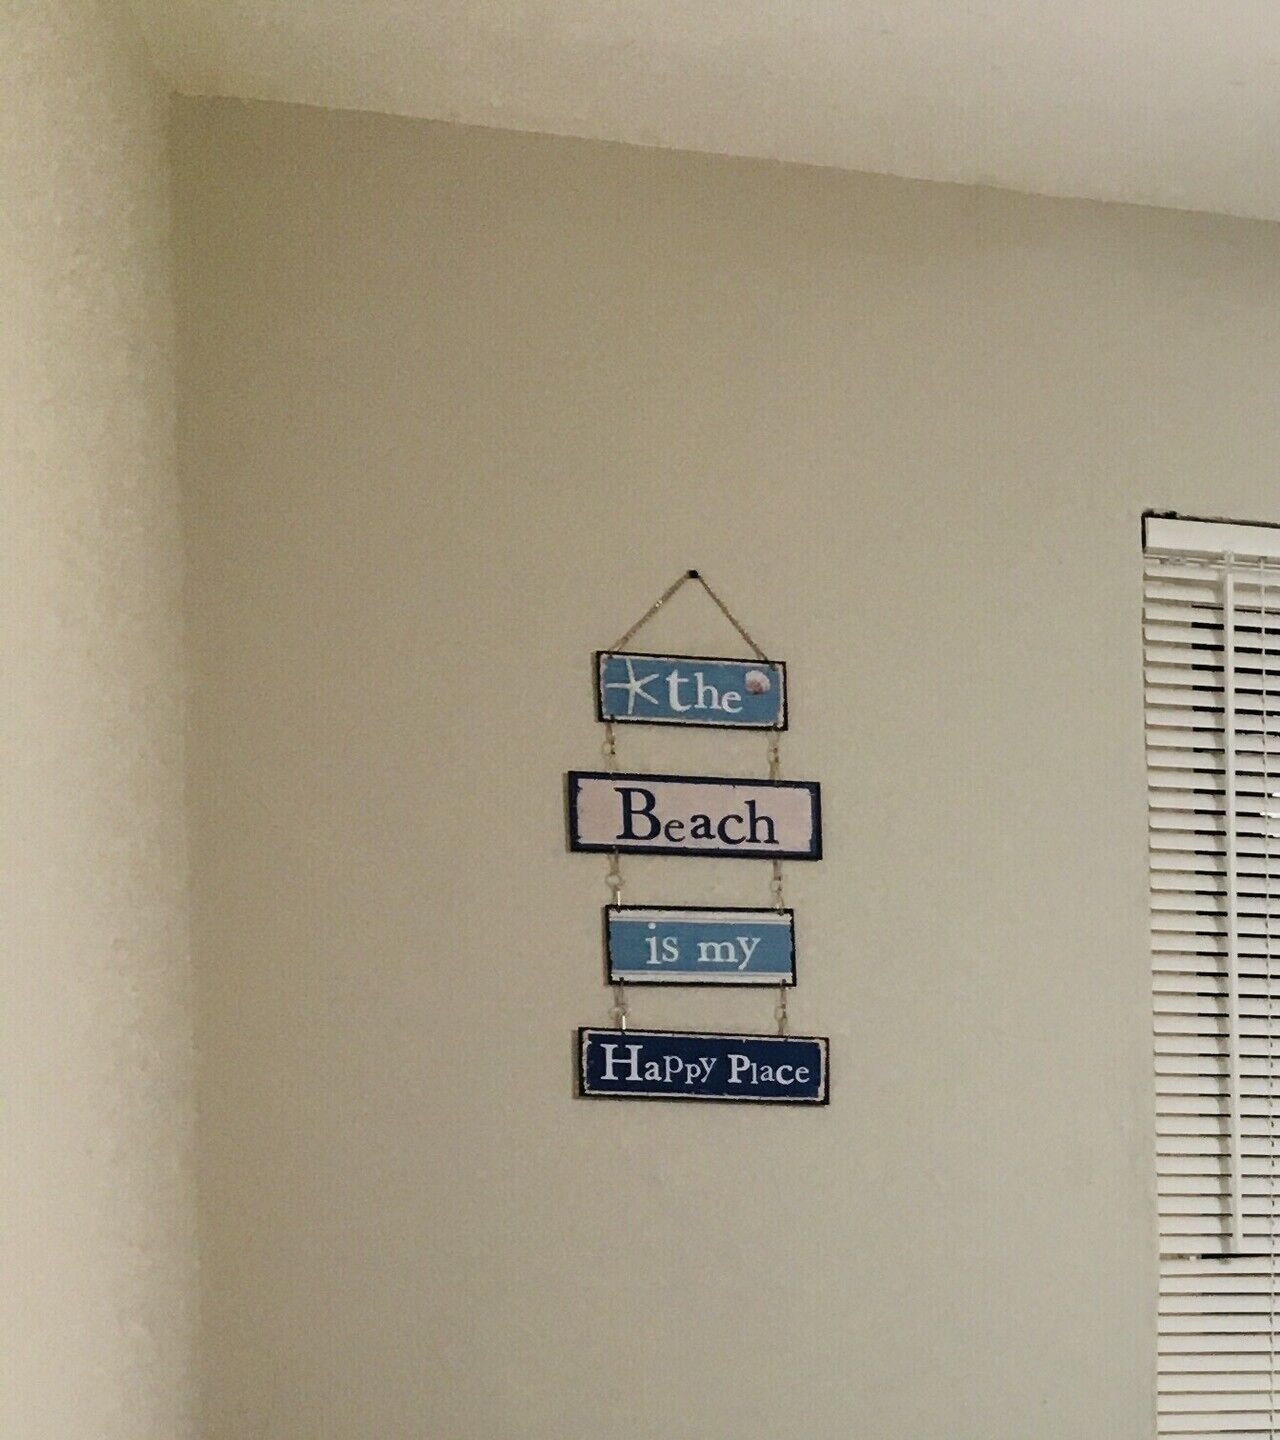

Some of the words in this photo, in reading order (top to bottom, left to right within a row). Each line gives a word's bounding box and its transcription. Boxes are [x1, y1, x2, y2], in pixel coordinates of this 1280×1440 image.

[665, 668, 743, 714] the
[613, 786, 780, 845] Beach
[645, 922, 679, 965] is
[697, 936, 762, 970] my
[600, 1043, 718, 1085] Happy
[727, 1053, 811, 1086] Place
